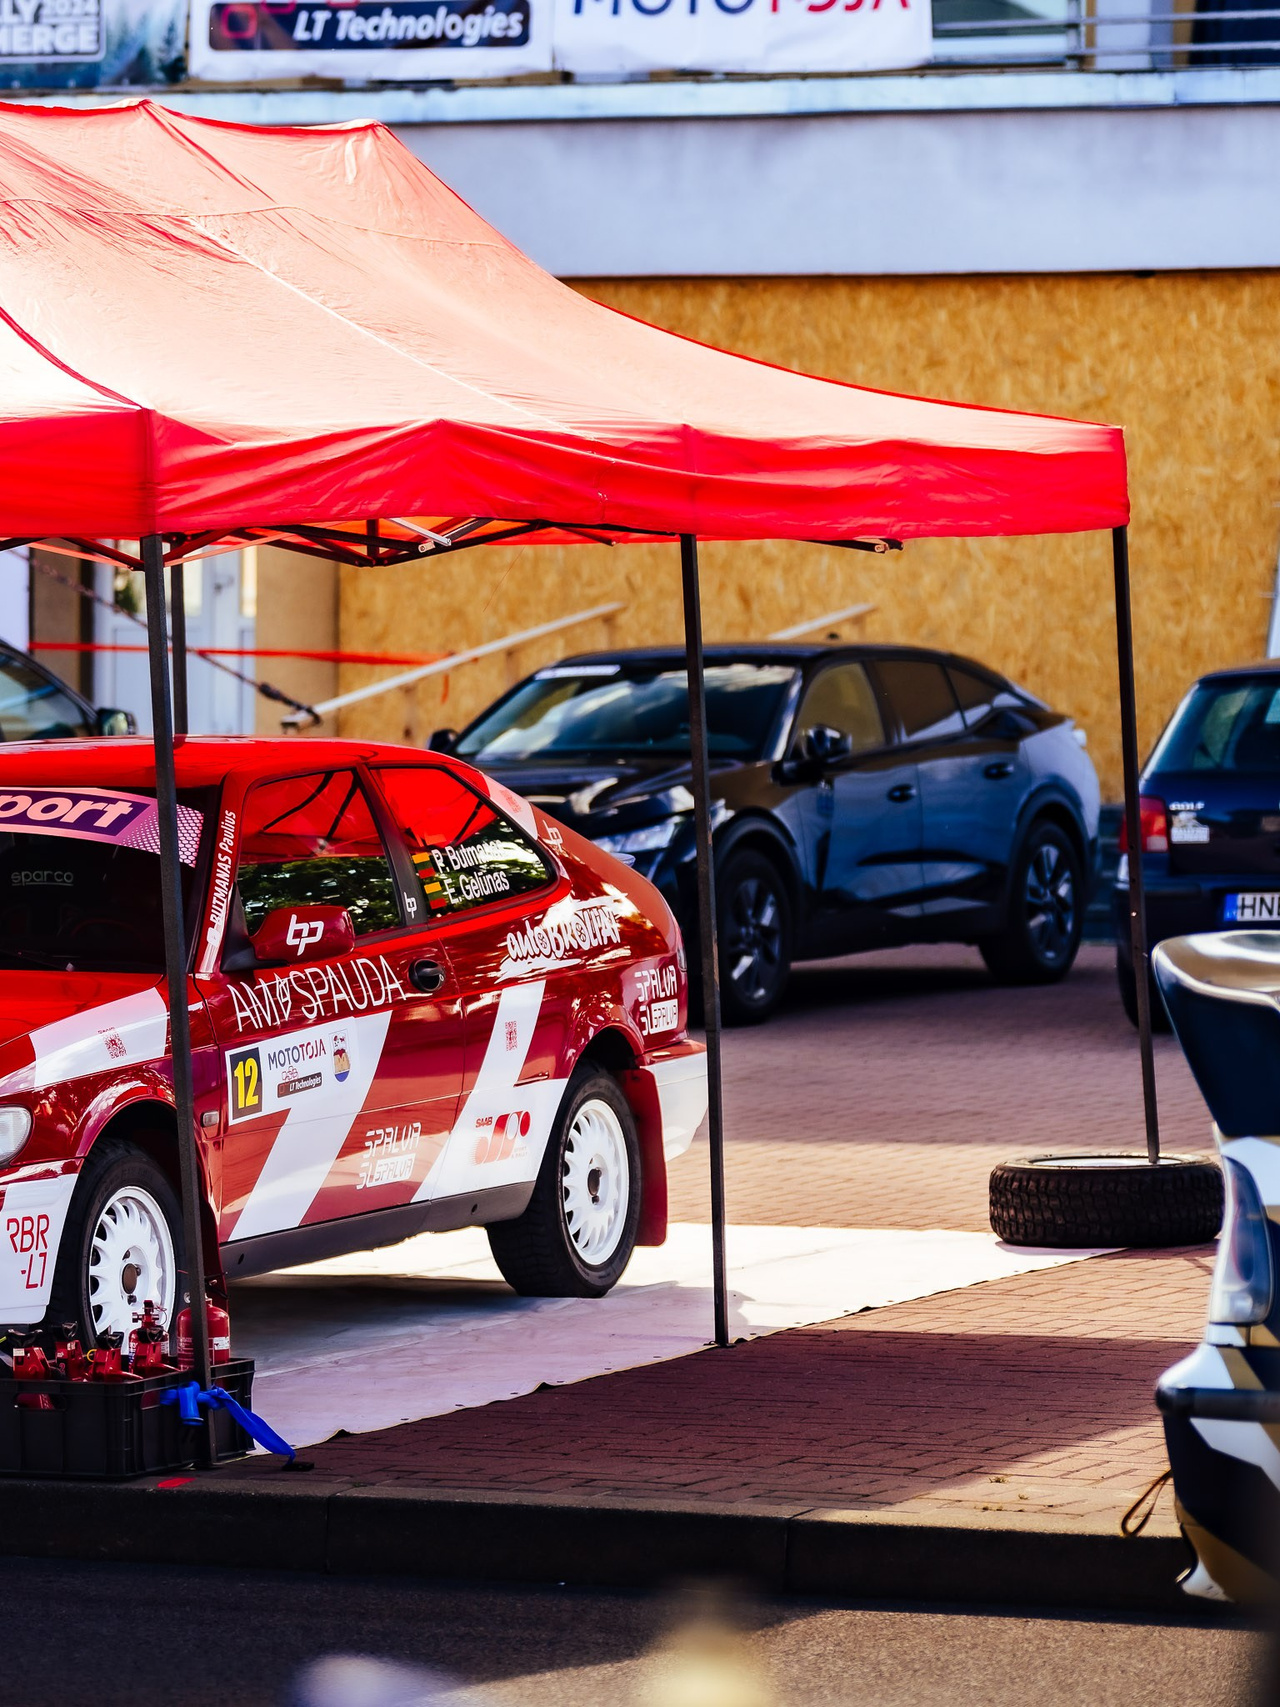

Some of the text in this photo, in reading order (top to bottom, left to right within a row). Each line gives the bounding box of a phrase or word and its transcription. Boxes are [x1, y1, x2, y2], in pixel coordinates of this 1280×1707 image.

[293, 5, 524, 46] LT Technologies
[219, 809, 236, 854] Paulius
[11, 870, 74, 886] sparco
[209, 853, 233, 926] BUTMANAS
[458, 870, 510, 901] Gelūnas
[1240, 896, 1280, 917] HN
[289, 954, 407, 1020] SPAUDA
[634, 964, 678, 1003] SPALVA
[267, 1038, 327, 1071] MOTOTOJA
[233, 1057, 259, 1109] 12
[363, 1121, 422, 1159] SPALVA
[476, 1116, 493, 1128] SAAB
[6, 1213, 50, 1254] RBR
